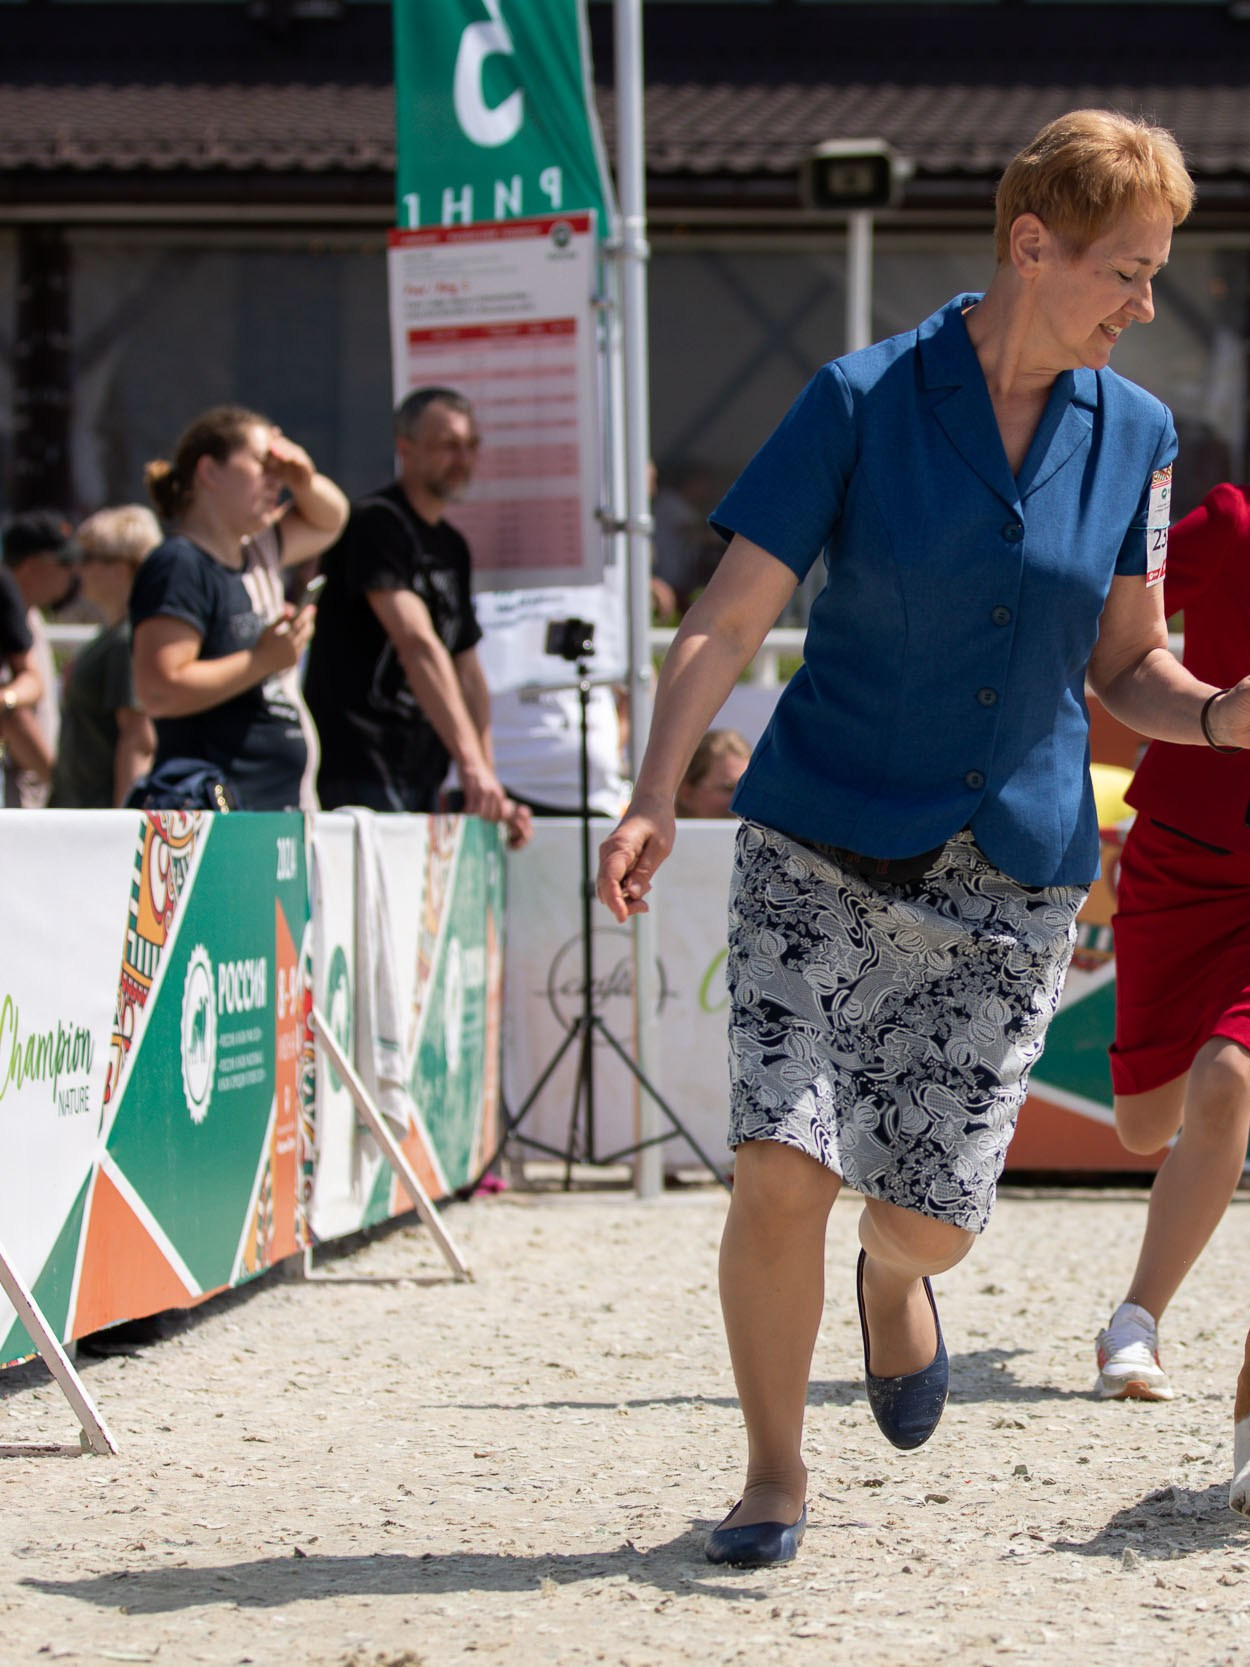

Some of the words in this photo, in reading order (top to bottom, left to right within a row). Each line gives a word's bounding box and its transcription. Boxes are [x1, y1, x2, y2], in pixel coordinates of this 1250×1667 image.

[218, 956, 267, 1015] РОССИЯ
[0, 993, 94, 1104] Champion
[58, 1085, 90, 1117] NATURE
